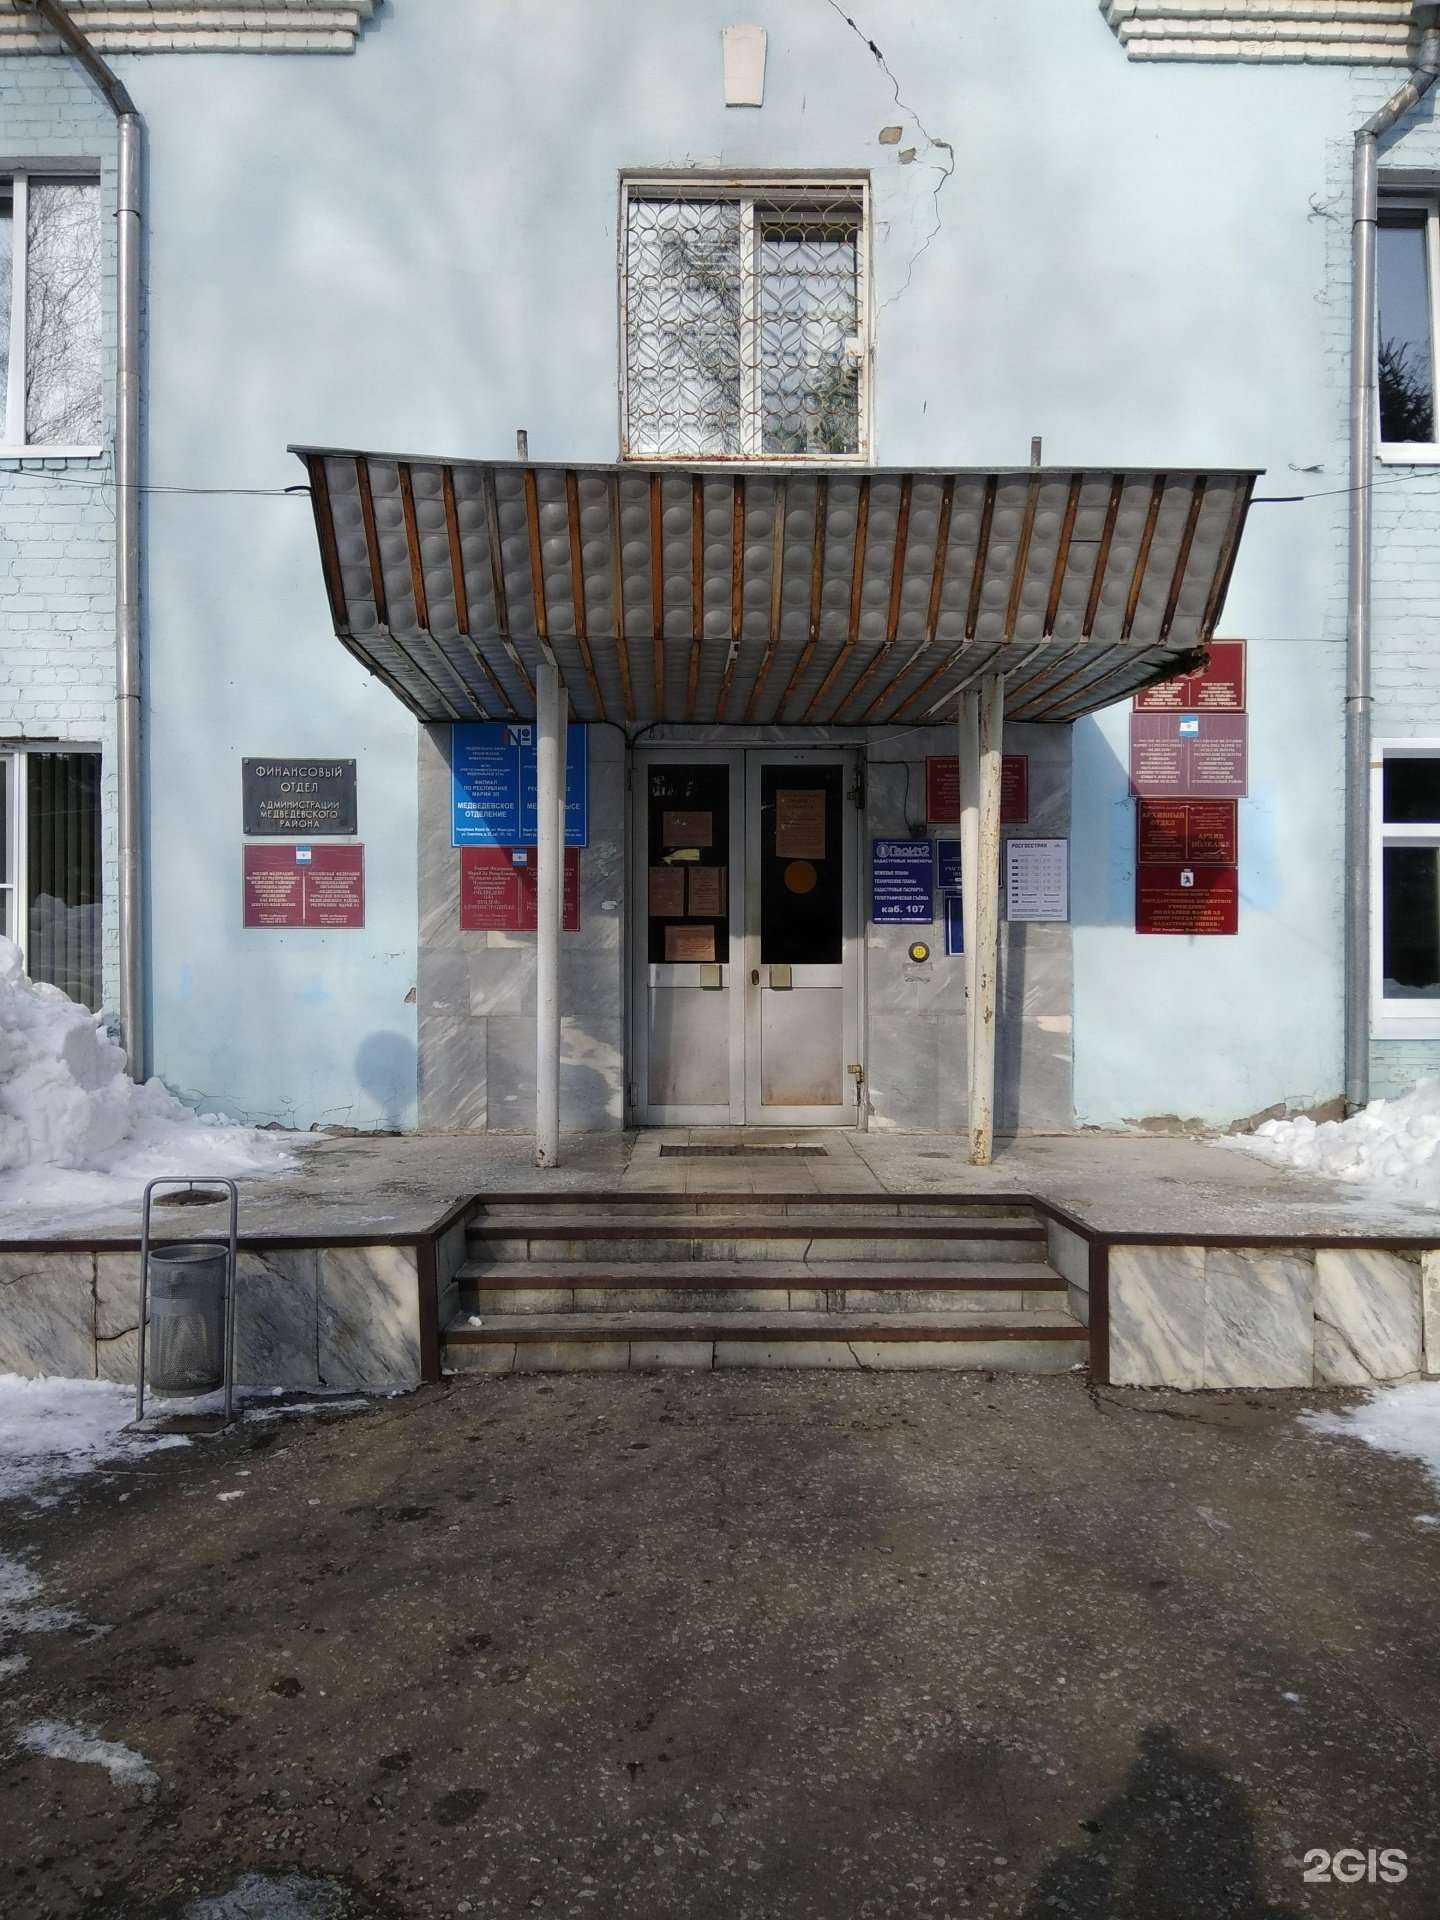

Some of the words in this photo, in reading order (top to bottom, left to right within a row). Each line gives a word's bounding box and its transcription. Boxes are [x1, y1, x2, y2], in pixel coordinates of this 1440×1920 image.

[255, 766, 343, 777] ФИНАНСОВЫЙ
[280, 782, 318, 793] ОТДЕЛ
[259, 800, 340, 810] АДМИНИСТРАЦИИ
[457, 802, 514, 810] МЕДВЕДЕВСКОЕ
[260, 810, 338, 819] МЕДВЕДЕВСКОГО
[280, 819, 320, 828] РАЙОНА
[881, 904, 903, 913] каб.
[905, 905, 925, 913] 107
